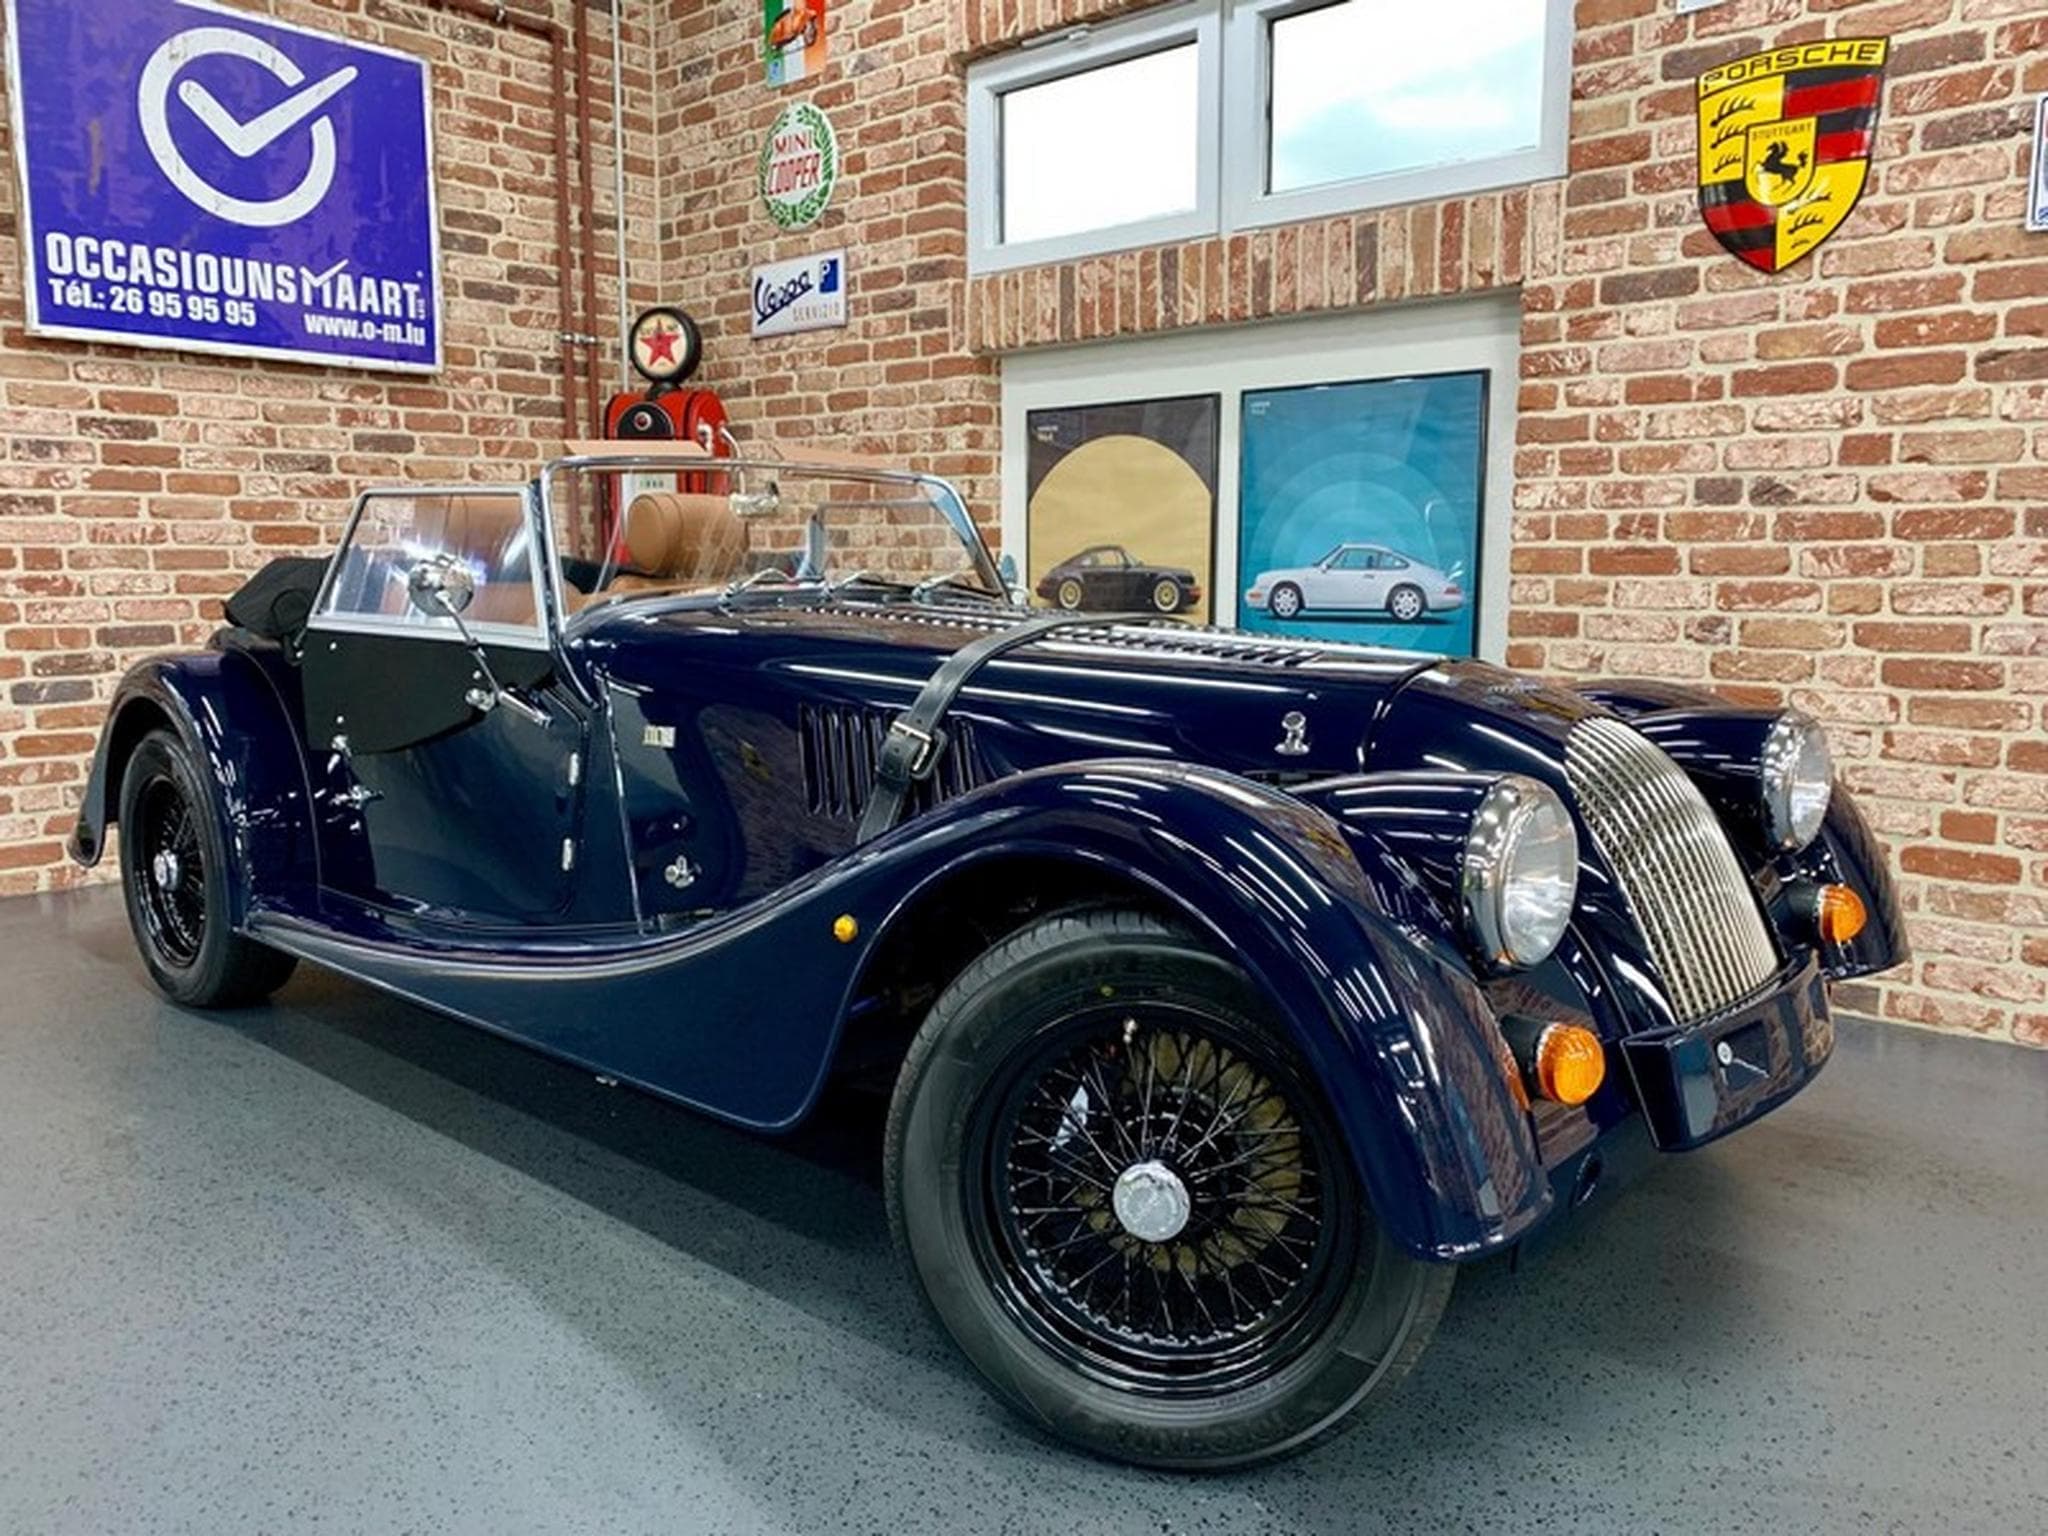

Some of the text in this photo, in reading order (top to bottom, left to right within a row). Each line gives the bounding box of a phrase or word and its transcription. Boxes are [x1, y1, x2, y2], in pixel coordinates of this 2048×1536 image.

[1703, 43, 1881, 92] PORSCHE
[774, 131, 813, 153] MINI
[1751, 122, 1812, 142] STUTTGART
[768, 153, 821, 195] COOPER
[48, 278, 257, 328] Tél.: 26 95 95 95
[754, 270, 813, 325] Vespa
[303, 313, 426, 347] www.o-m.lu
